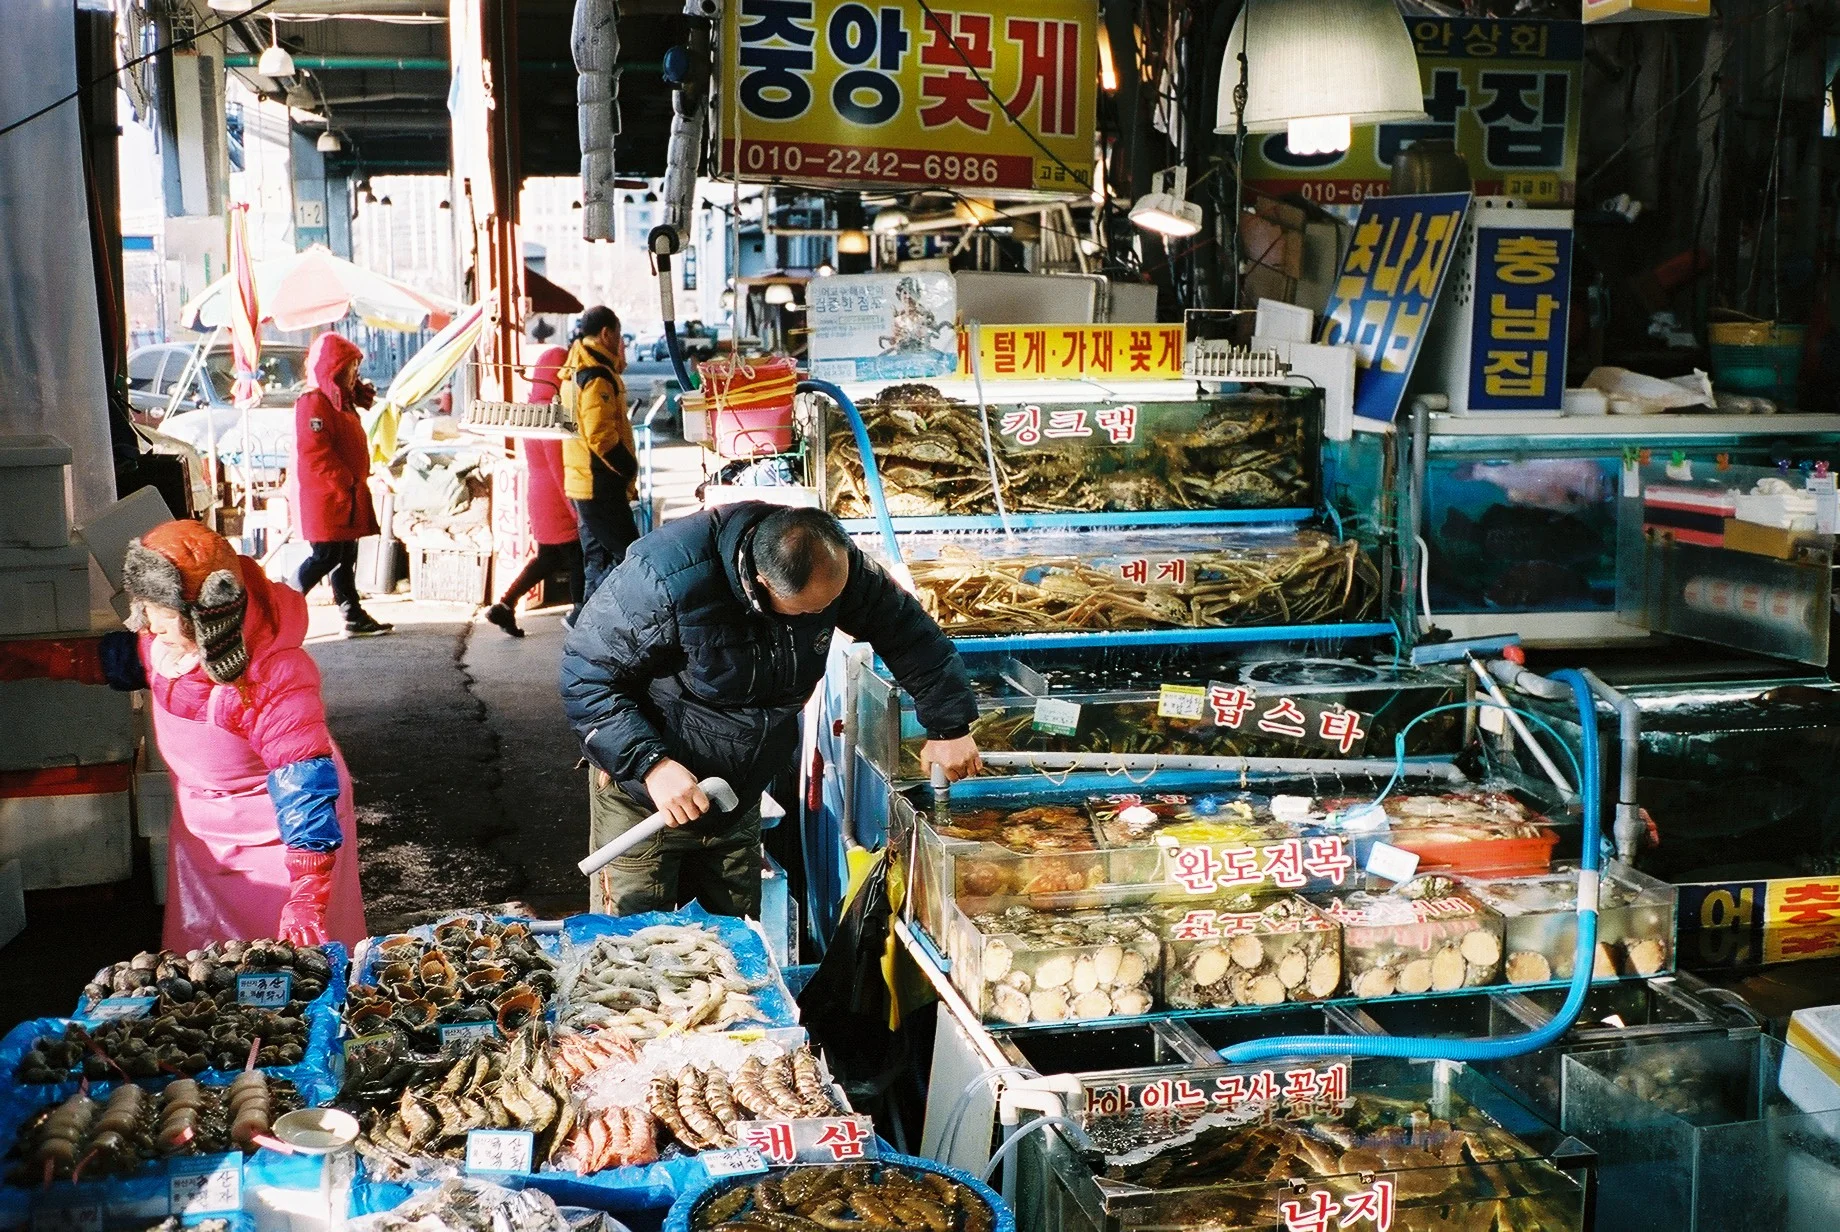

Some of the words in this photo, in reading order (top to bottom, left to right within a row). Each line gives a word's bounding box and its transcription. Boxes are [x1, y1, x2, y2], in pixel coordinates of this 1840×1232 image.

[747, 144, 999, 184] 010-2242-6986
[1302, 182, 1391, 202] 010-641
[1484, 235, 1561, 397] 충남집
[1000, 404, 1137, 446] 킹크랩
[1208, 685, 1365, 754] 랍스타
[1172, 836, 1353, 895] 완도전복
